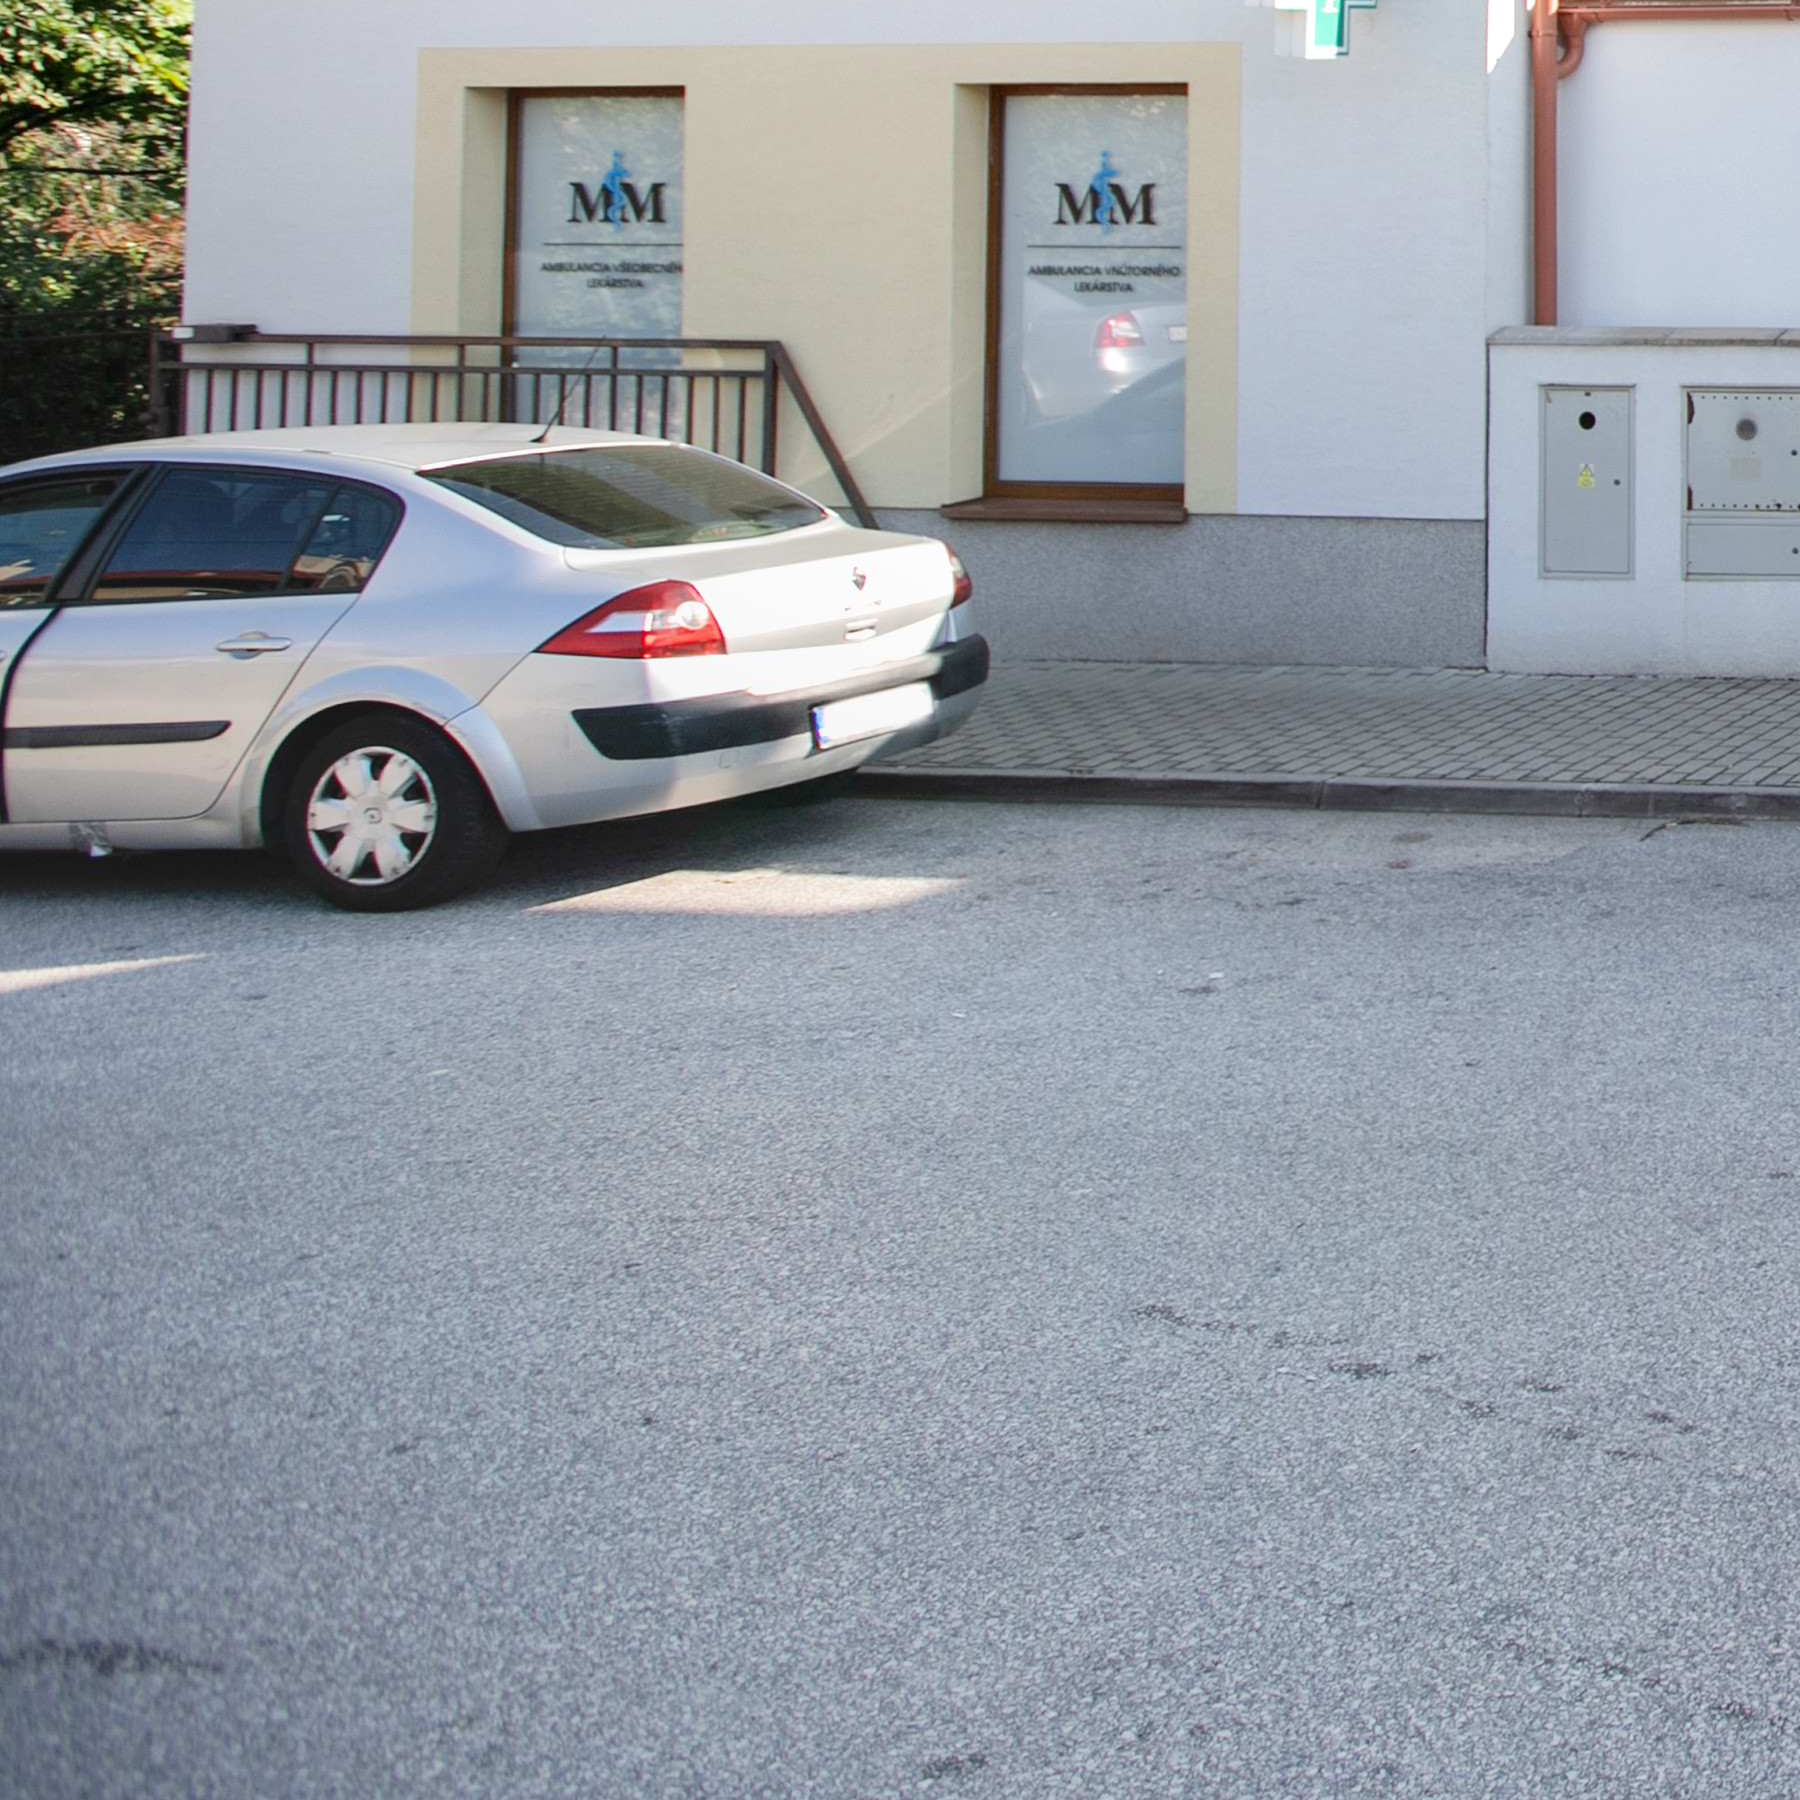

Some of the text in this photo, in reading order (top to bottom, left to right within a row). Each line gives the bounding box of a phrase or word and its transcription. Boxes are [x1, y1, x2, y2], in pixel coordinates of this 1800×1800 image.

[541, 262, 610, 272] AMBULANCIA
[1028, 263, 1181, 277] AMBULANCIA VNÚTORNÉHO
[1074, 279, 1134, 292] LEKÁRSTVA
